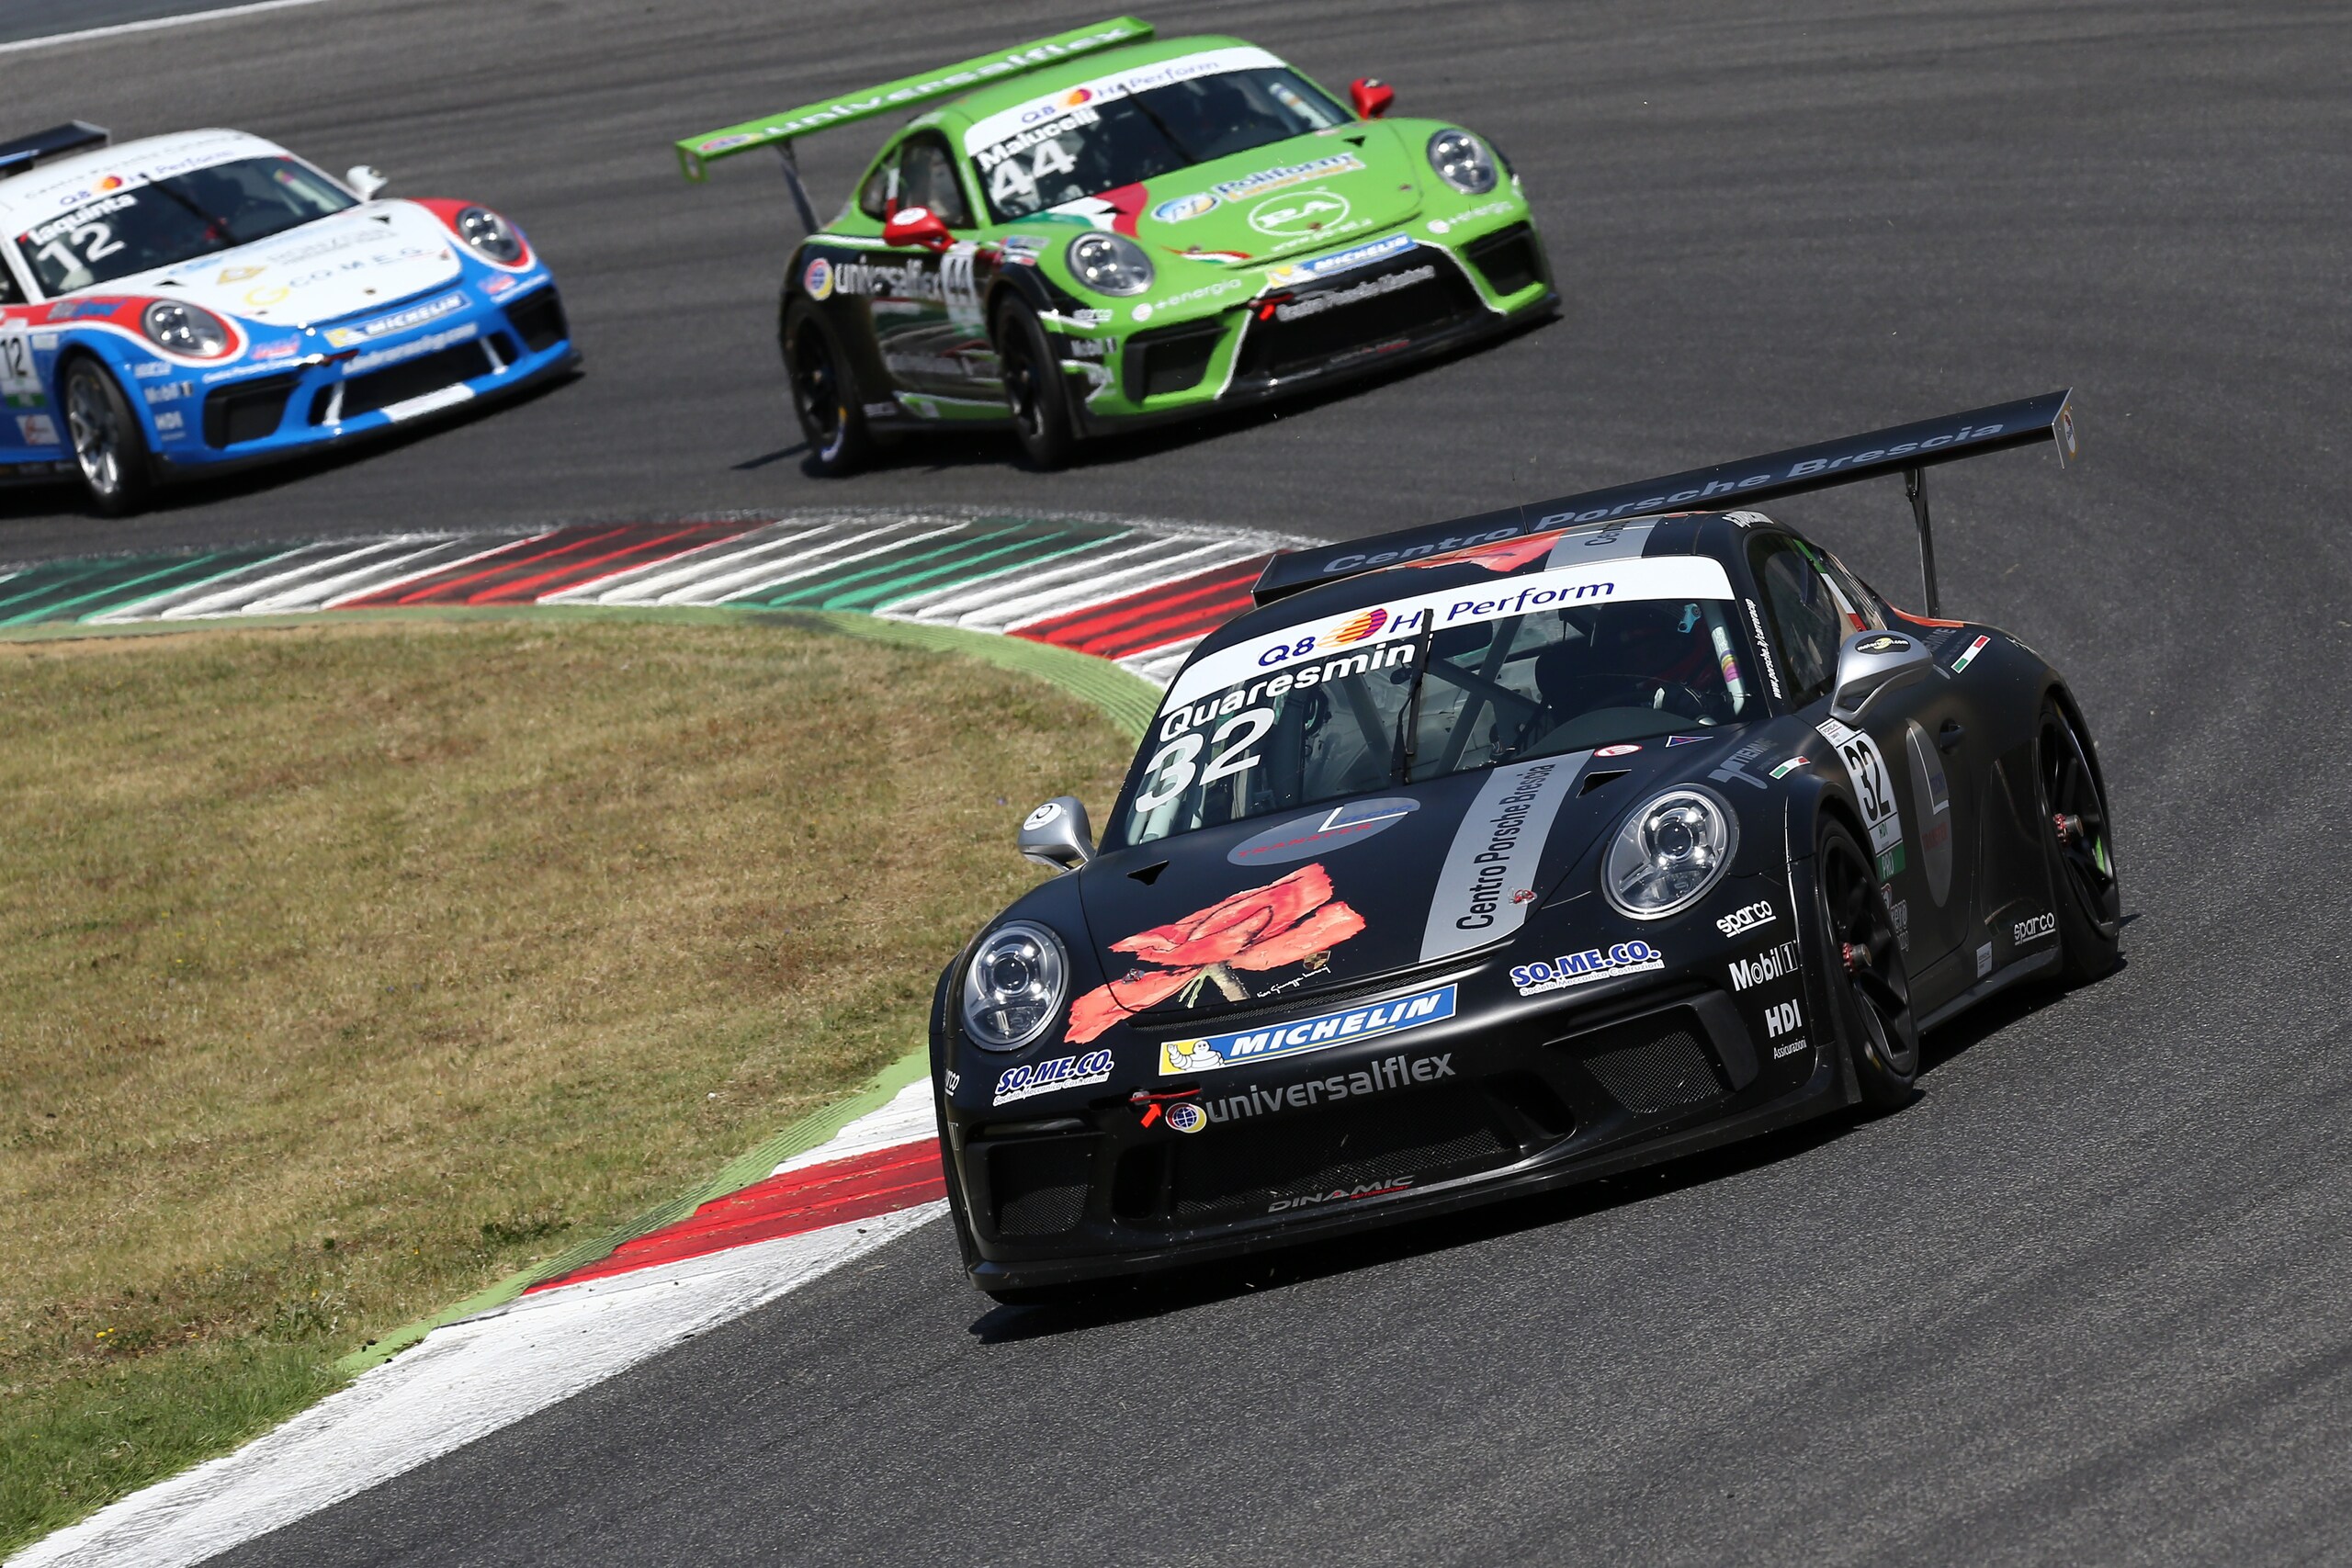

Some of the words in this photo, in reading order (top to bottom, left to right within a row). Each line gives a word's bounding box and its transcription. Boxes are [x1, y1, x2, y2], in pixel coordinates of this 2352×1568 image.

[764, 28, 1133, 135] universalflex
[977, 105, 1101, 172] Malucelli
[990, 139, 1077, 201] 44
[36, 221, 127, 273] 12
[1314, 235, 1408, 269] MICHELIN
[1322, 525, 1521, 573] Centro
[1532, 471, 1771, 533] Porsche
[1785, 423, 2005, 479] Brescia
[1258, 636, 1316, 667] Q8
[1388, 610, 1423, 634] H
[1447, 580, 1615, 622] Perform
[1159, 633, 1433, 742] Quaresmin
[1135, 707, 1275, 813] 32
[1499, 762, 1556, 805] Brescia
[1844, 740, 1891, 822] 32
[1474, 805, 1529, 864] Porsche
[1882, 851, 1894, 879] PRO
[1456, 863, 1505, 931] Centro
[1716, 900, 1776, 938] sparco
[2014, 912, 2056, 945] sparco
[1511, 941, 1659, 987] SO.ME.CO.
[1610, 961, 1664, 976] Costruzioni
[1728, 947, 1783, 991] Mobil
[1230, 988, 1442, 1056] MICHELIN
[1765, 998, 1803, 1038] HDI
[996, 1050, 1114, 1094] SO.ME.CO.
[1773, 1035, 1807, 1059] Assicurazioni
[1207, 1053, 1456, 1124] universalflex
[1268, 1175, 1415, 1213] DINAMIC
